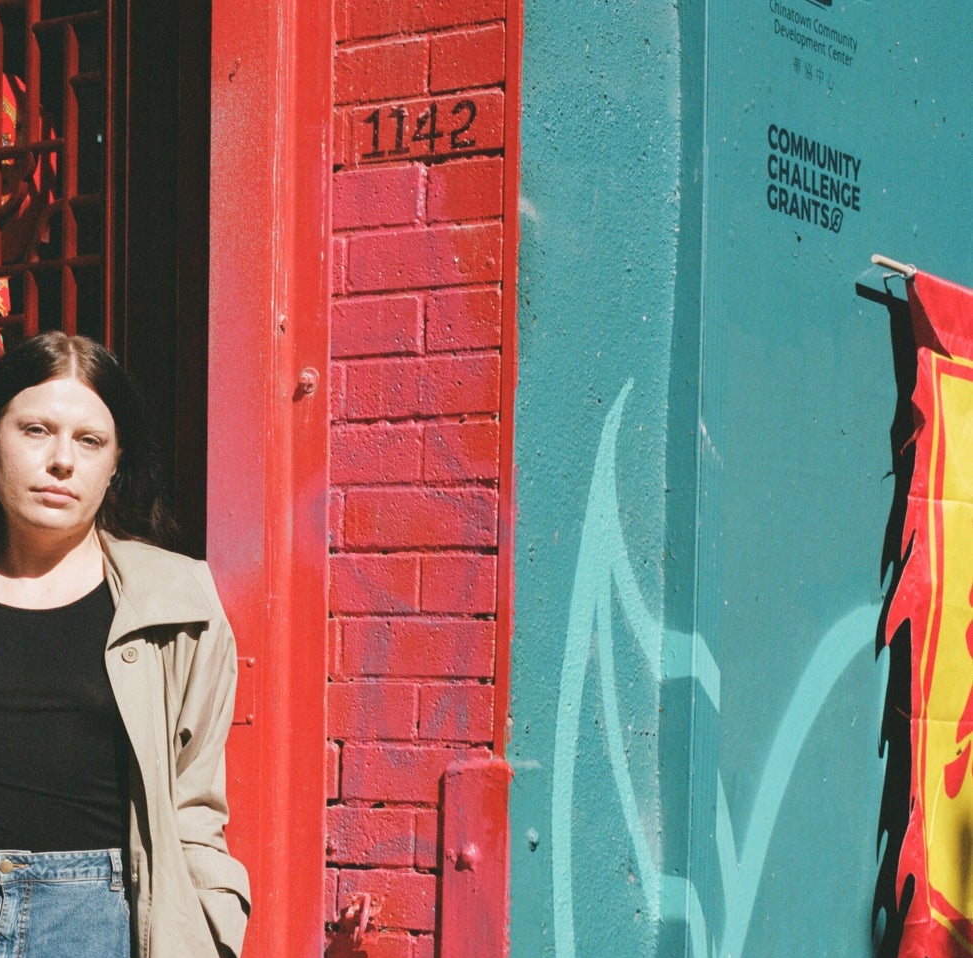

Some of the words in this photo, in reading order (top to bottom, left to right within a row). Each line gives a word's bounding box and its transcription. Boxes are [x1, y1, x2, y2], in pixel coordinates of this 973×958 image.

[769, 0, 812, 28] Chinatown
[814, 19, 858, 53] Community
[774, 19, 826, 56] Development
[828, 45, 853, 67] Center
[362, 100, 477, 159] 1142
[768, 124, 861, 182] COMMUNITY
[767, 154, 861, 212] CHALLENGE
[767, 184, 830, 230] GRANTS
